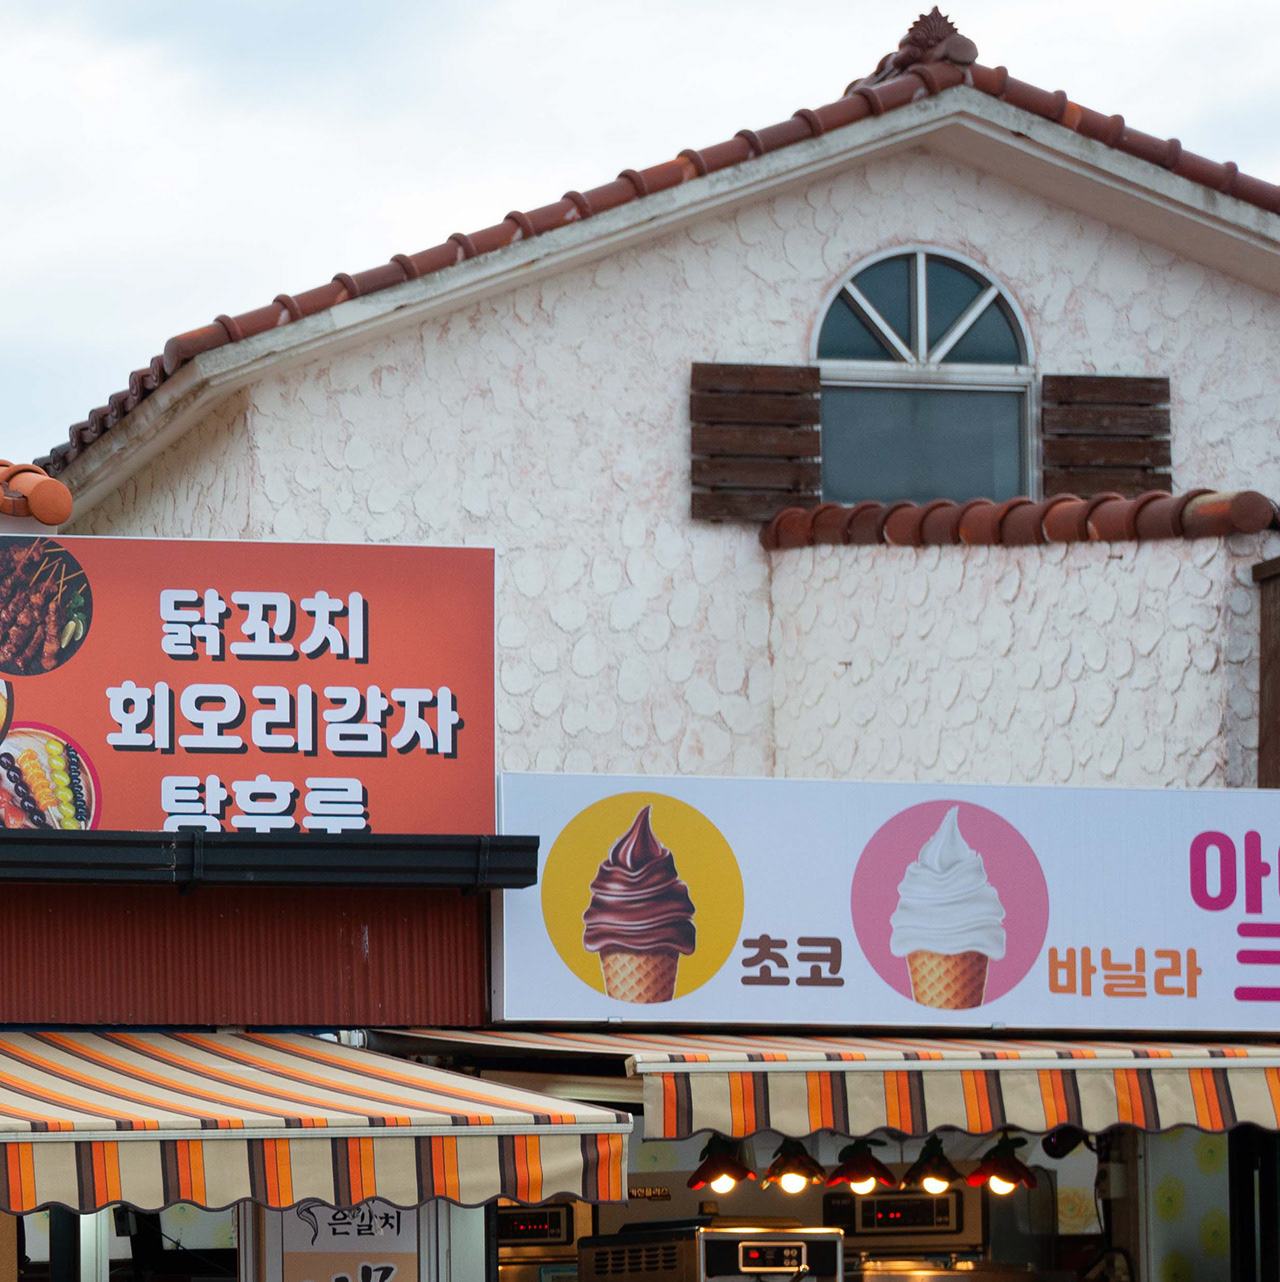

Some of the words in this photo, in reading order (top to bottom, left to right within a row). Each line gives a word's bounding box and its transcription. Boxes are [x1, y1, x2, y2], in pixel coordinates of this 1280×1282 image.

[160, 588, 367, 661] 닭꼬치
[105, 680, 464, 757] 회오리감자
[160, 773, 370, 835] 탕후루
[1190, 829, 1280, 915] 아
[740, 933, 845, 988] 초코
[1048, 945, 1203, 999] 바닐라
